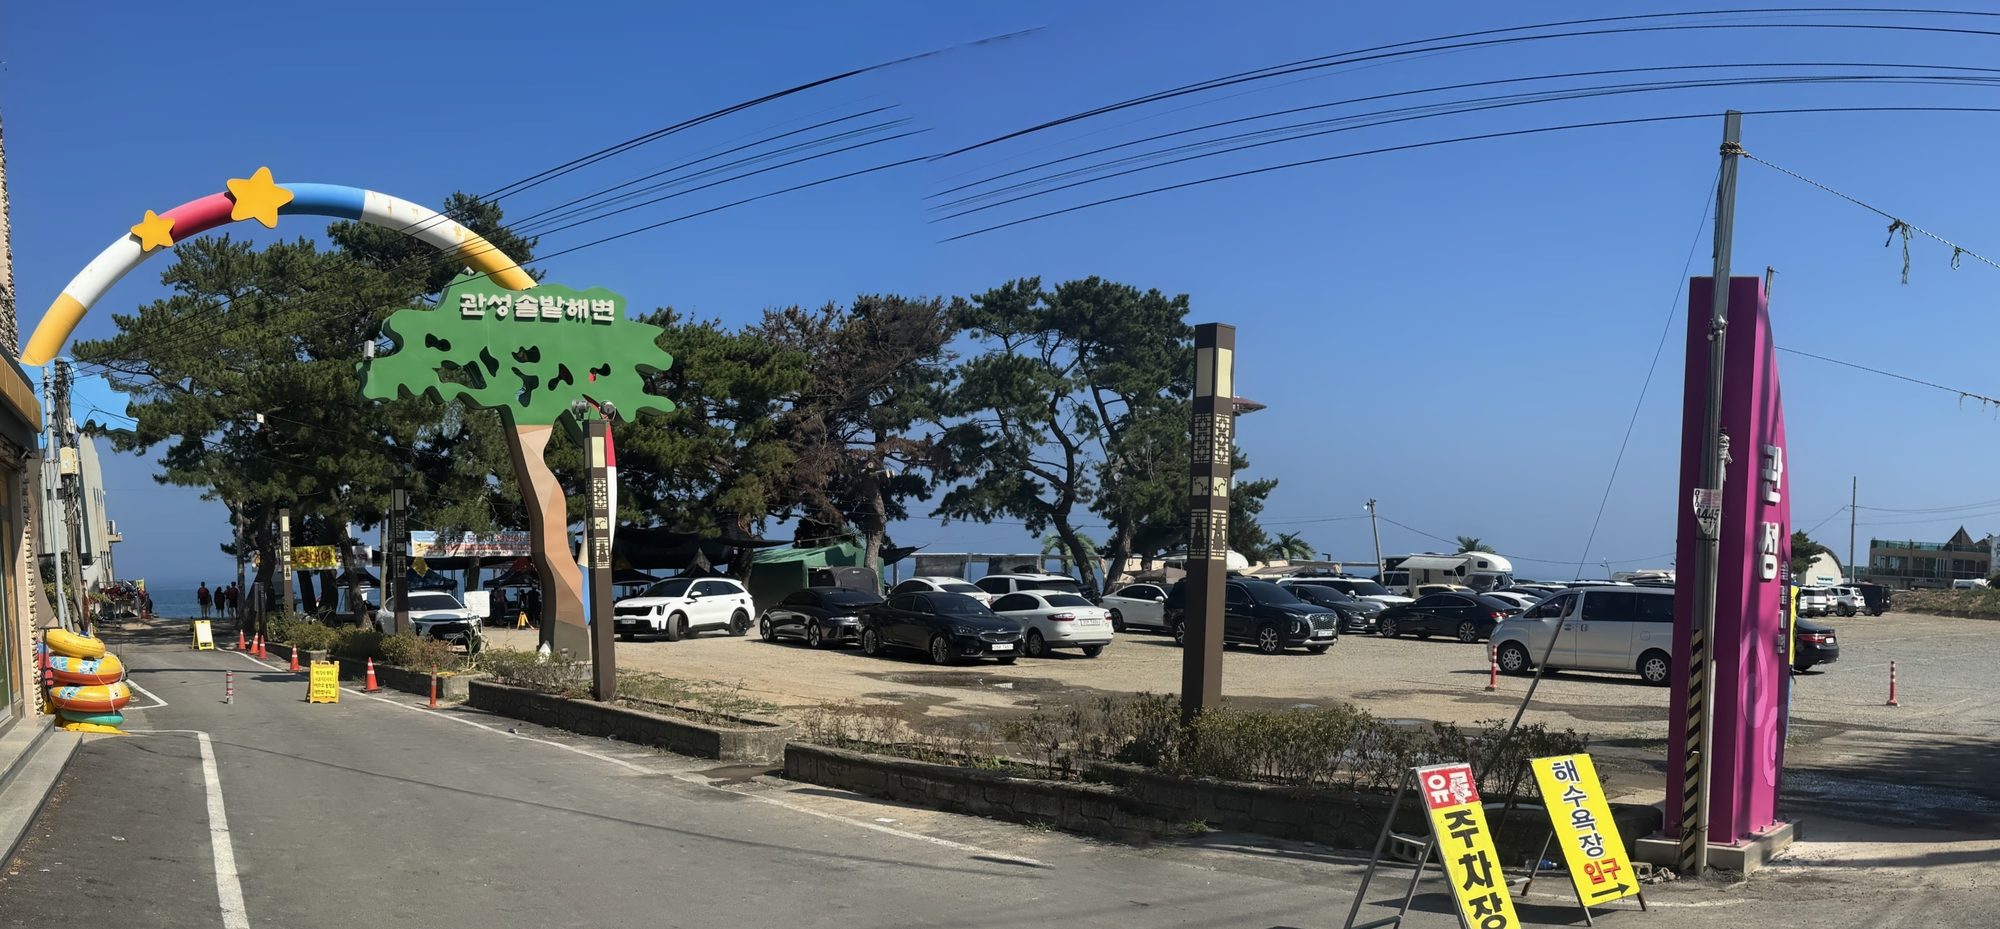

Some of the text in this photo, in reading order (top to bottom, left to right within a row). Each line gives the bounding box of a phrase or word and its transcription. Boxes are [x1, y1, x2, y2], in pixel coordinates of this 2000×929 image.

[460, 292, 615, 322] 관성솔밭해변
[1551, 759, 1606, 858] 해수욕장
[1444, 809, 1507, 929] 주차장
[1583, 857, 1621, 885] 입구
